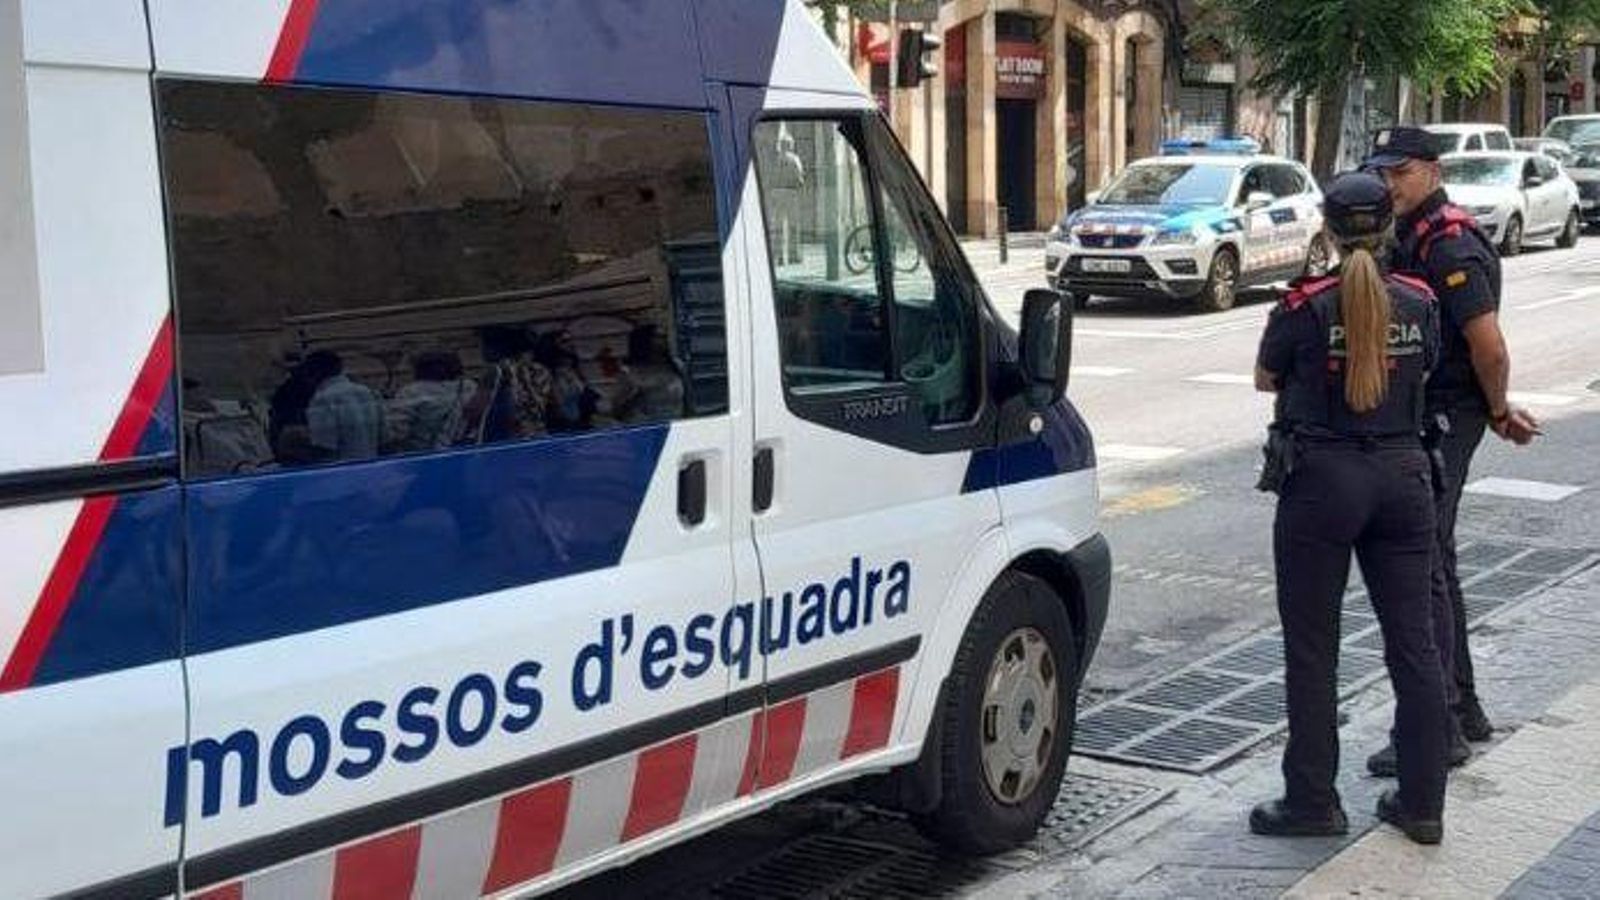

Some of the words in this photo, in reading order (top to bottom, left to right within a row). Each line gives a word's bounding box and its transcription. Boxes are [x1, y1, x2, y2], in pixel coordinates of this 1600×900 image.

[1328, 323, 1423, 346] PCIA
[843, 396, 907, 419] TRANSIT
[164, 659, 543, 827] mossos
[572, 557, 911, 711] d'esquadra
